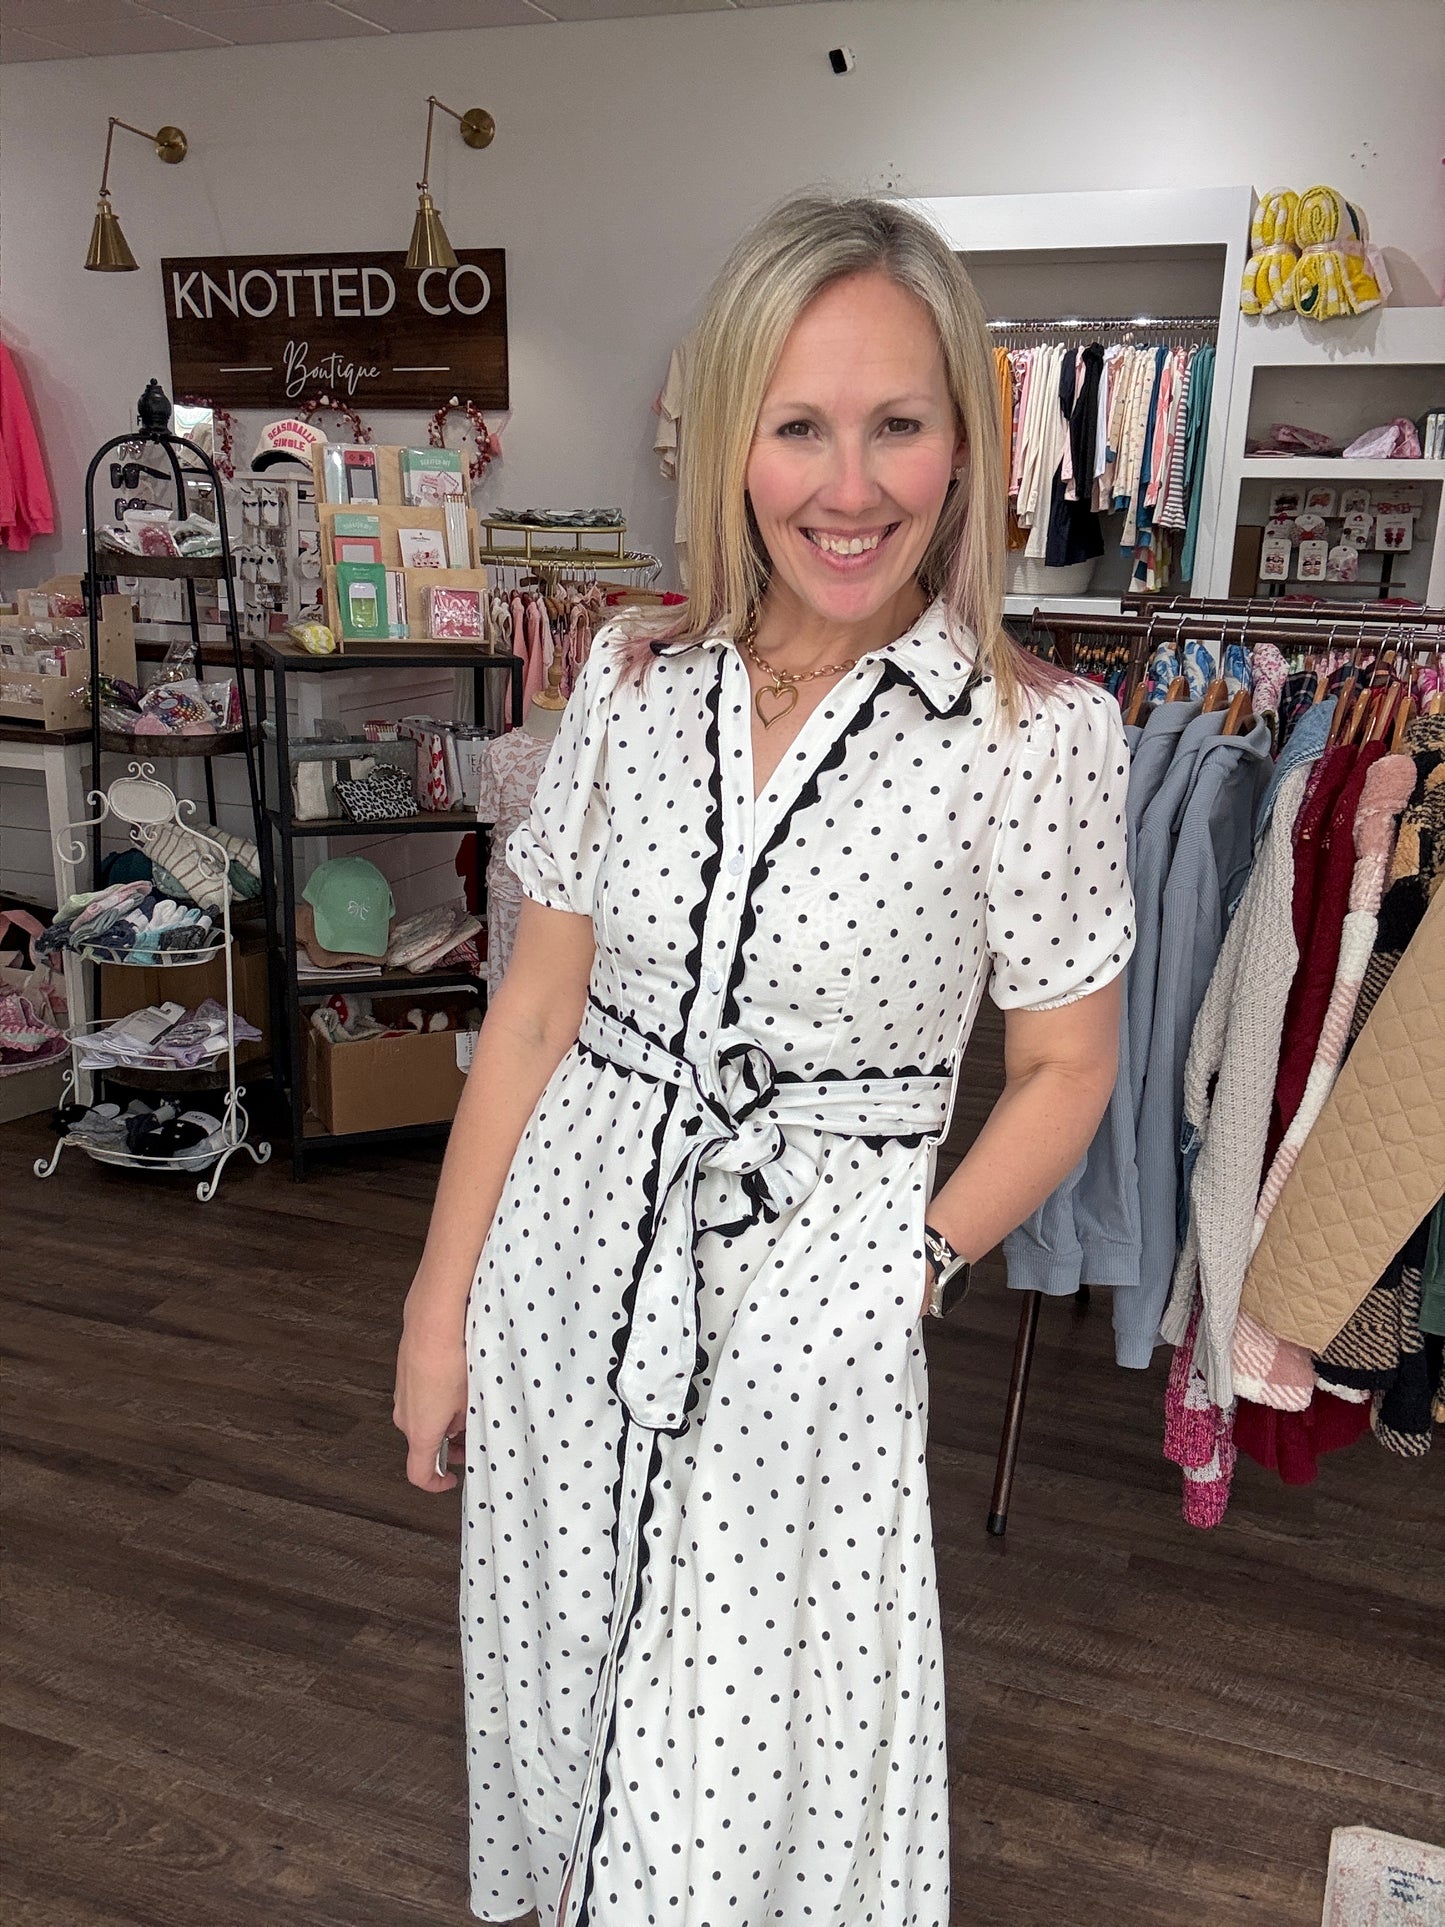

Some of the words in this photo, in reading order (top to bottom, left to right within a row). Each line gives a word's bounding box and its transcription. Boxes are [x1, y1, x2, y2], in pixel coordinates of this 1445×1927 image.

[172, 267, 396, 319] KNOTTED
[417, 264, 491, 316] CO
[283, 340, 380, 398] Boutique
[267, 421, 317, 444] SEASONALLY
[272, 438, 306, 452] SINGLE
